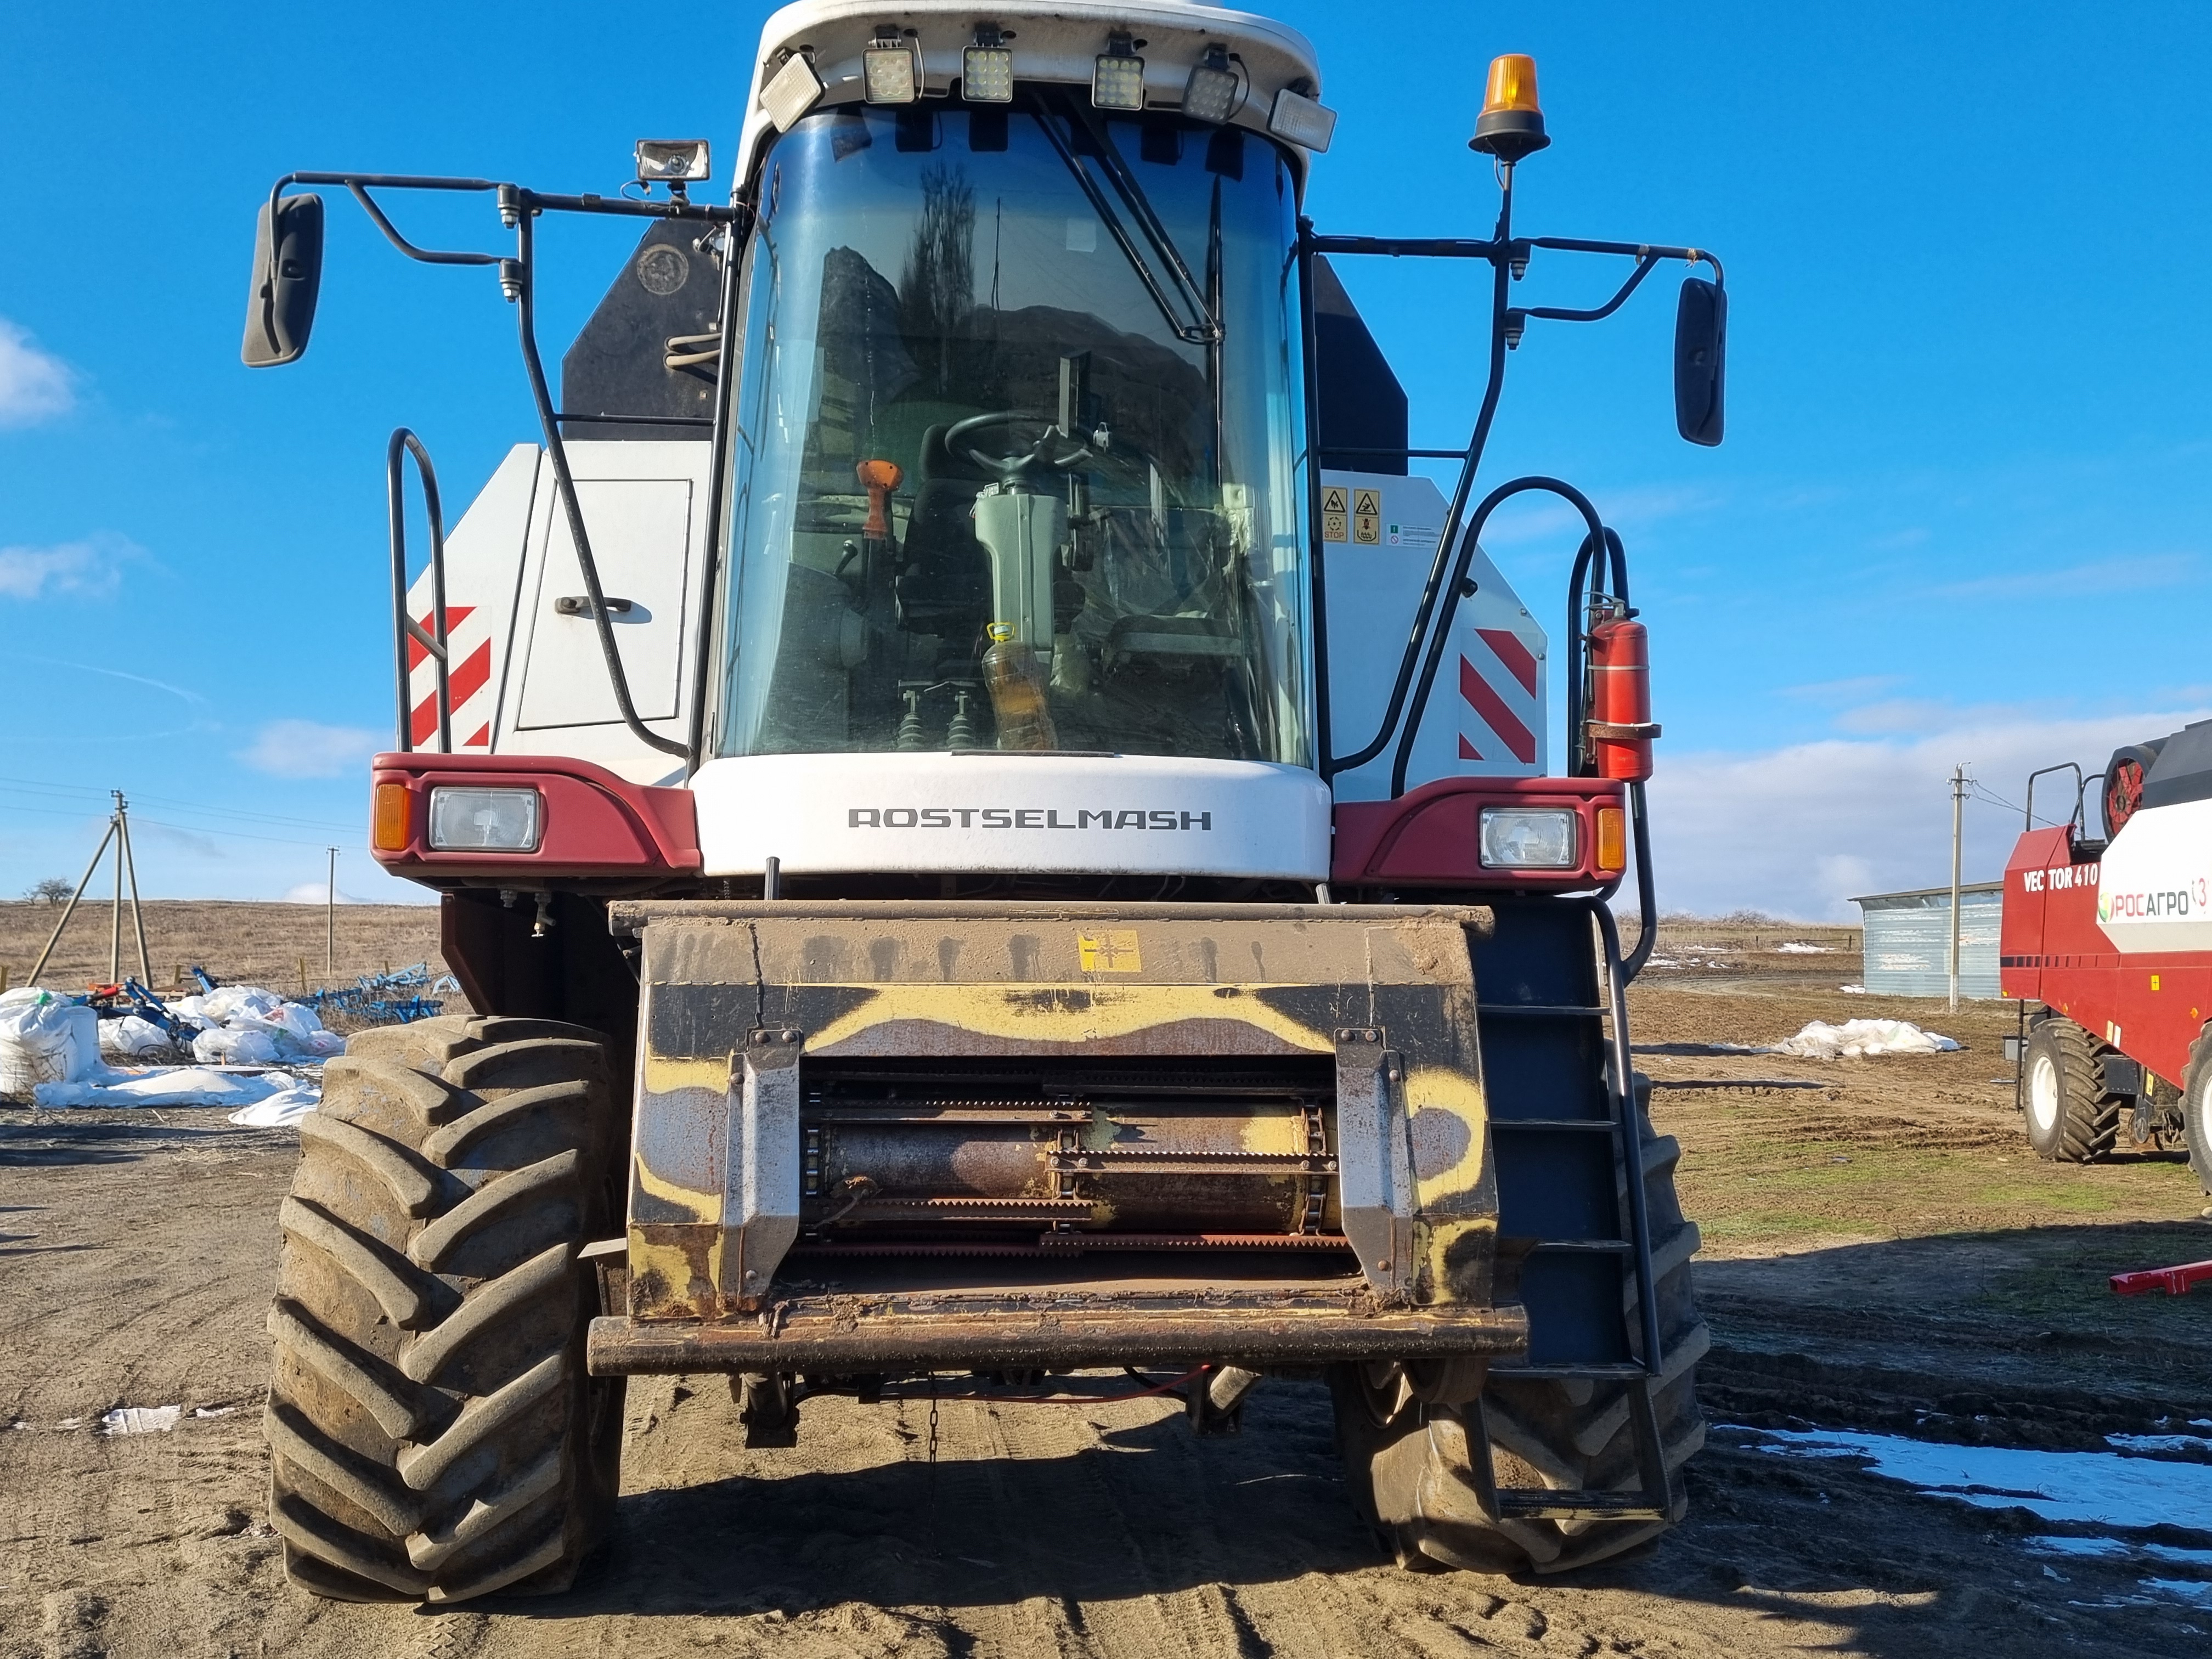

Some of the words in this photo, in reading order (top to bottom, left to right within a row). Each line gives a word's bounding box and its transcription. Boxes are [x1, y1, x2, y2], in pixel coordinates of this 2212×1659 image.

[848, 808, 1211, 831] ROSTSELMASH
[2074, 863, 2098, 887] 410
[2115, 890, 2189, 917] РОСАГРО
